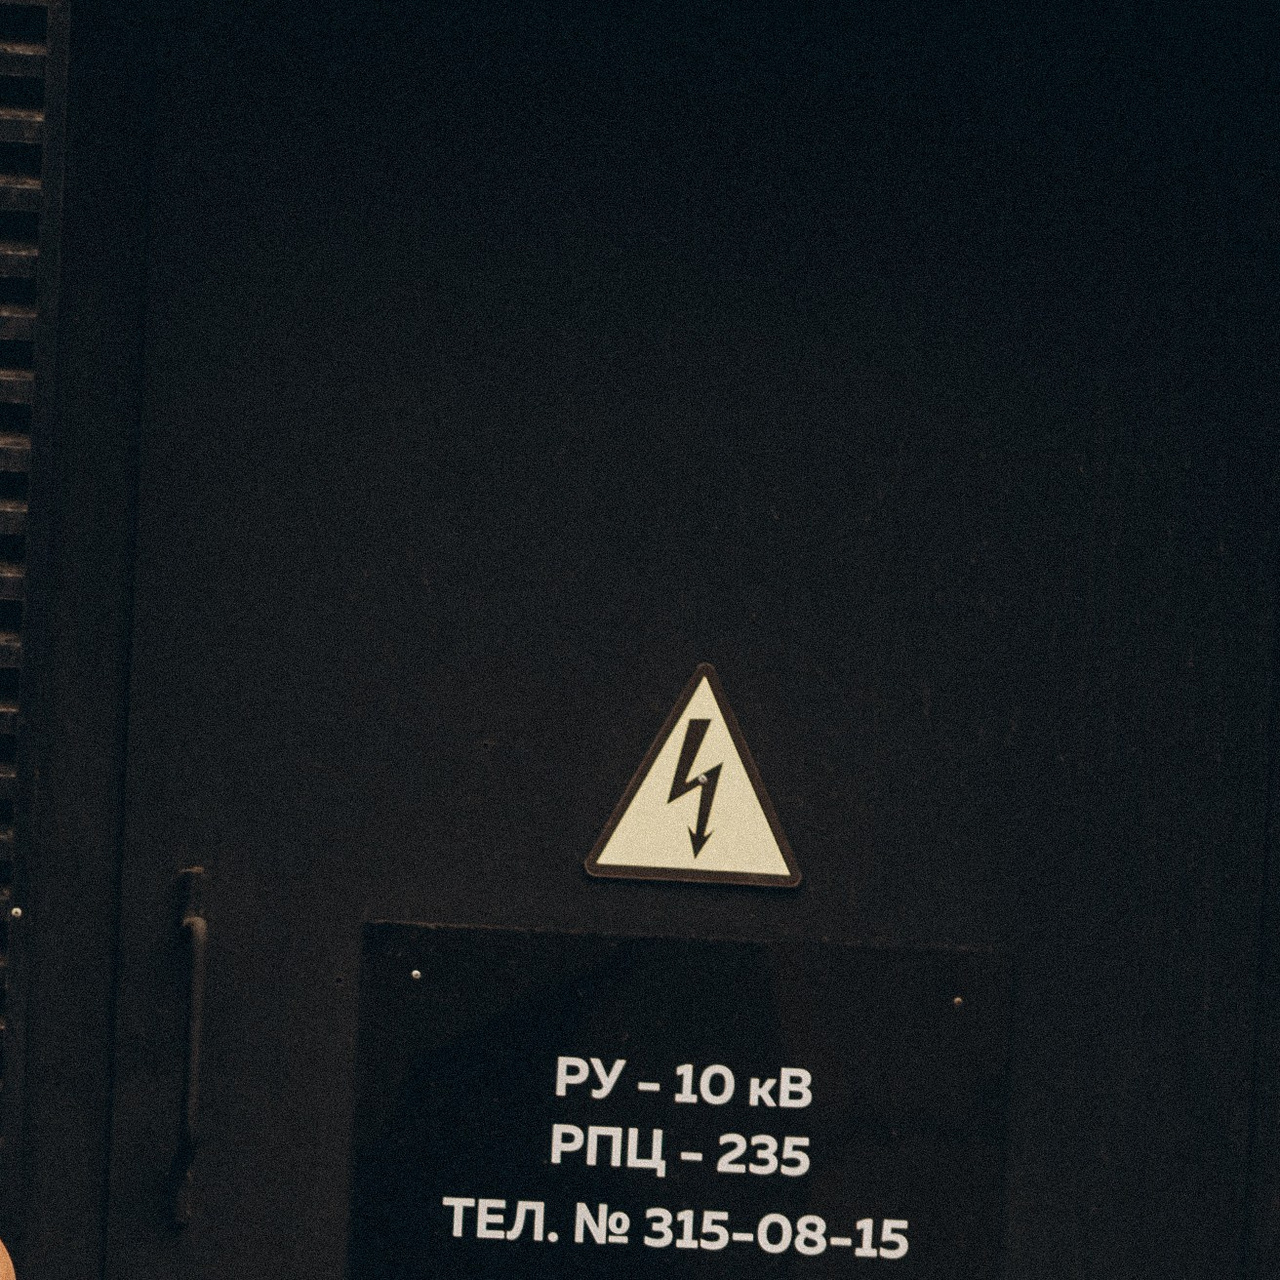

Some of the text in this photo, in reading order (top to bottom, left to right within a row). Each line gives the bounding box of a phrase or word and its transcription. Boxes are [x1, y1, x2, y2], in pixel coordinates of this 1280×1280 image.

[555, 1056, 627, 1099] РУ
[674, 1063, 735, 1105] 10
[749, 1067, 813, 1108] кВ
[550, 1123, 666, 1178] РПЦ
[716, 1133, 811, 1177] 235
[442, 1196, 909, 1259] ТЕЛ. № 315-08-15
